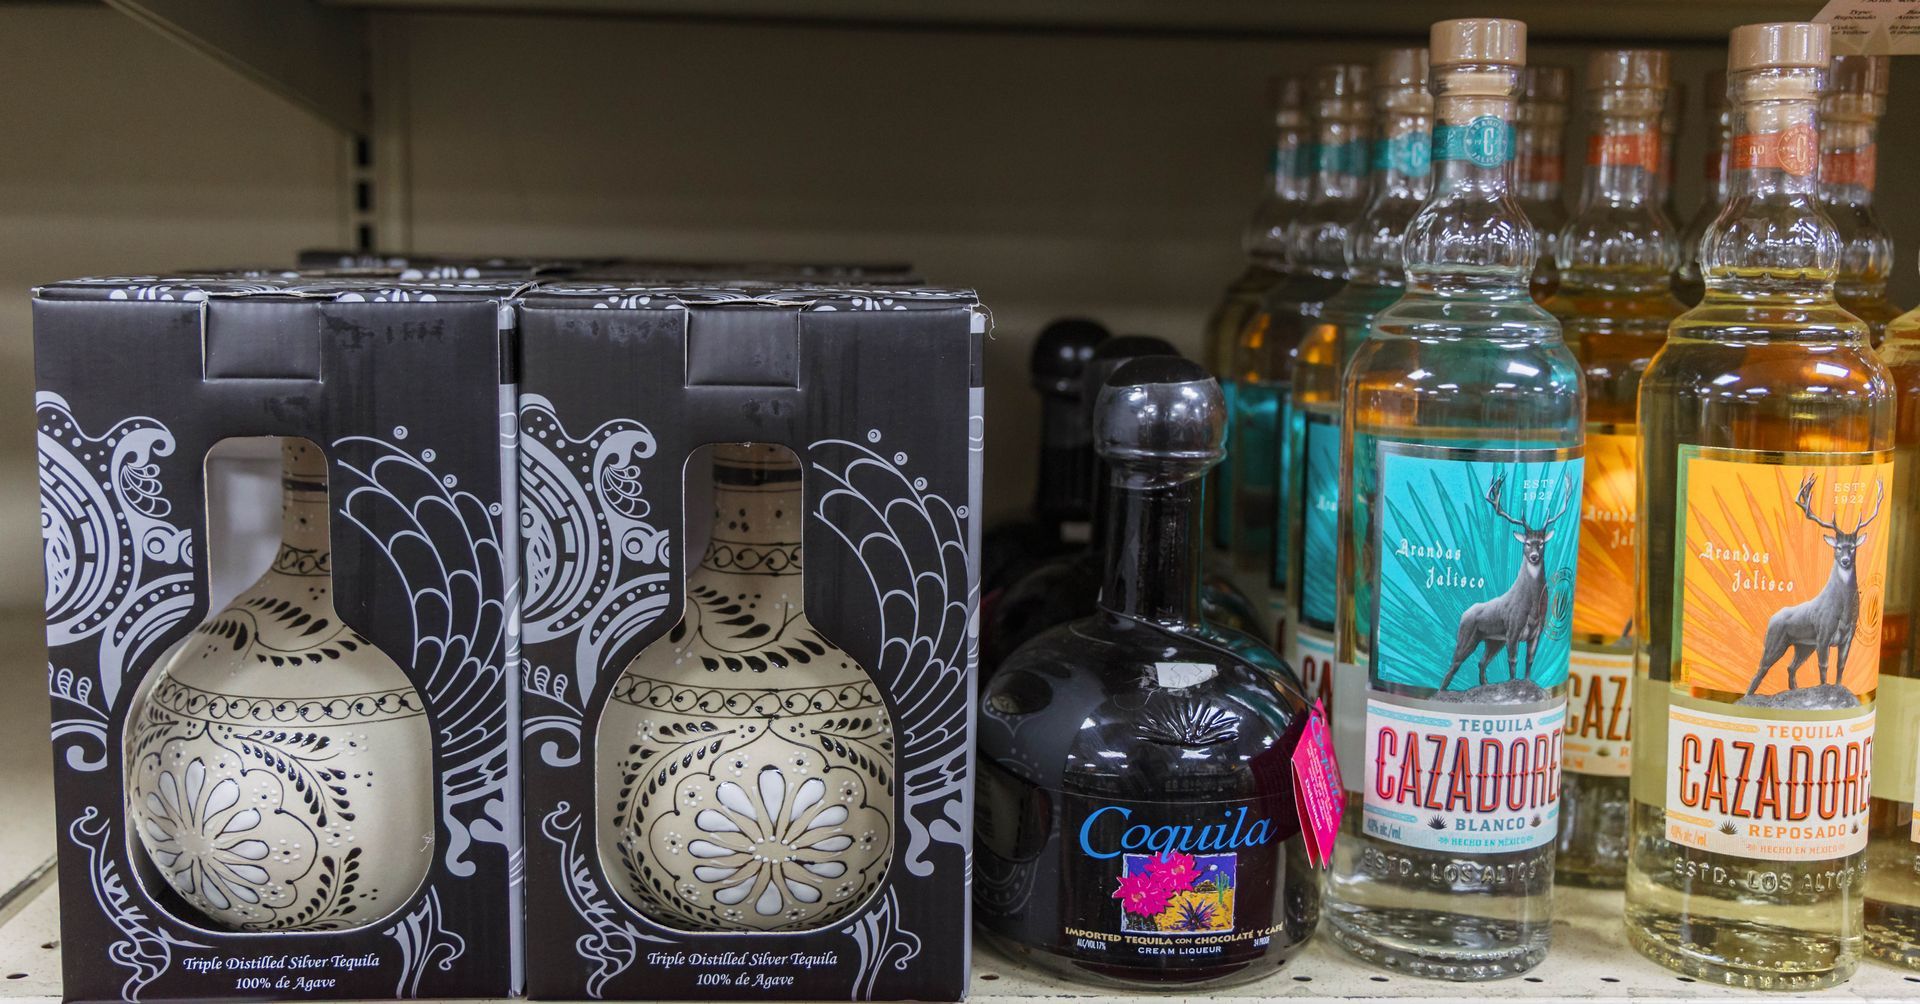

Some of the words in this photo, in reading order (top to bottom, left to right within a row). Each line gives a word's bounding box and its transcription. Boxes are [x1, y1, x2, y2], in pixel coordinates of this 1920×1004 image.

[1484, 127, 1495, 156] C
[1833, 495, 1865, 505] 1922
[1395, 538, 1461, 561] Arandas
[1699, 541, 1770, 564] Arandas
[1426, 566, 1485, 589] Jalisco
[1732, 569, 1794, 593] Jalisco
[1459, 718, 1534, 735] TEQUILA
[1767, 725, 1845, 742] TEQUILA
[1375, 726, 1564, 813] CAZADORE
[1455, 816, 1526, 832] BLANCO
[1749, 823, 1847, 839] REPOSADO
[1079, 806, 1277, 863] Coquila
[1451, 837, 1482, 847] HECHO
[1484, 839, 1495, 847] EN
[1431, 863, 1473, 884] LOS
[1674, 856, 1737, 887] ESTD.
[1748, 870, 1793, 893] LOS
[1065, 927, 1122, 942] IMPORTED
[1125, 936, 1173, 945] TEQUILA
[1138, 946, 1175, 955] CREAM
[1180, 946, 1222, 955] LIQUEUR
[183, 957, 222, 973] Triple
[226, 955, 287, 970] Distilled
[287, 954, 328, 969] Silver
[331, 953, 380, 972] Tequila
[647, 952, 685, 969] Triple
[688, 952, 748, 966] Distilled
[749, 952, 788, 966] Silver
[790, 951, 838, 968] Tequila
[235, 977, 271, 989] 100%
[275, 976, 290, 989] de
[292, 976, 336, 992] Agave
[696, 973, 731, 985] 100%
[735, 972, 750, 985] de
[752, 973, 794, 989] Agave
